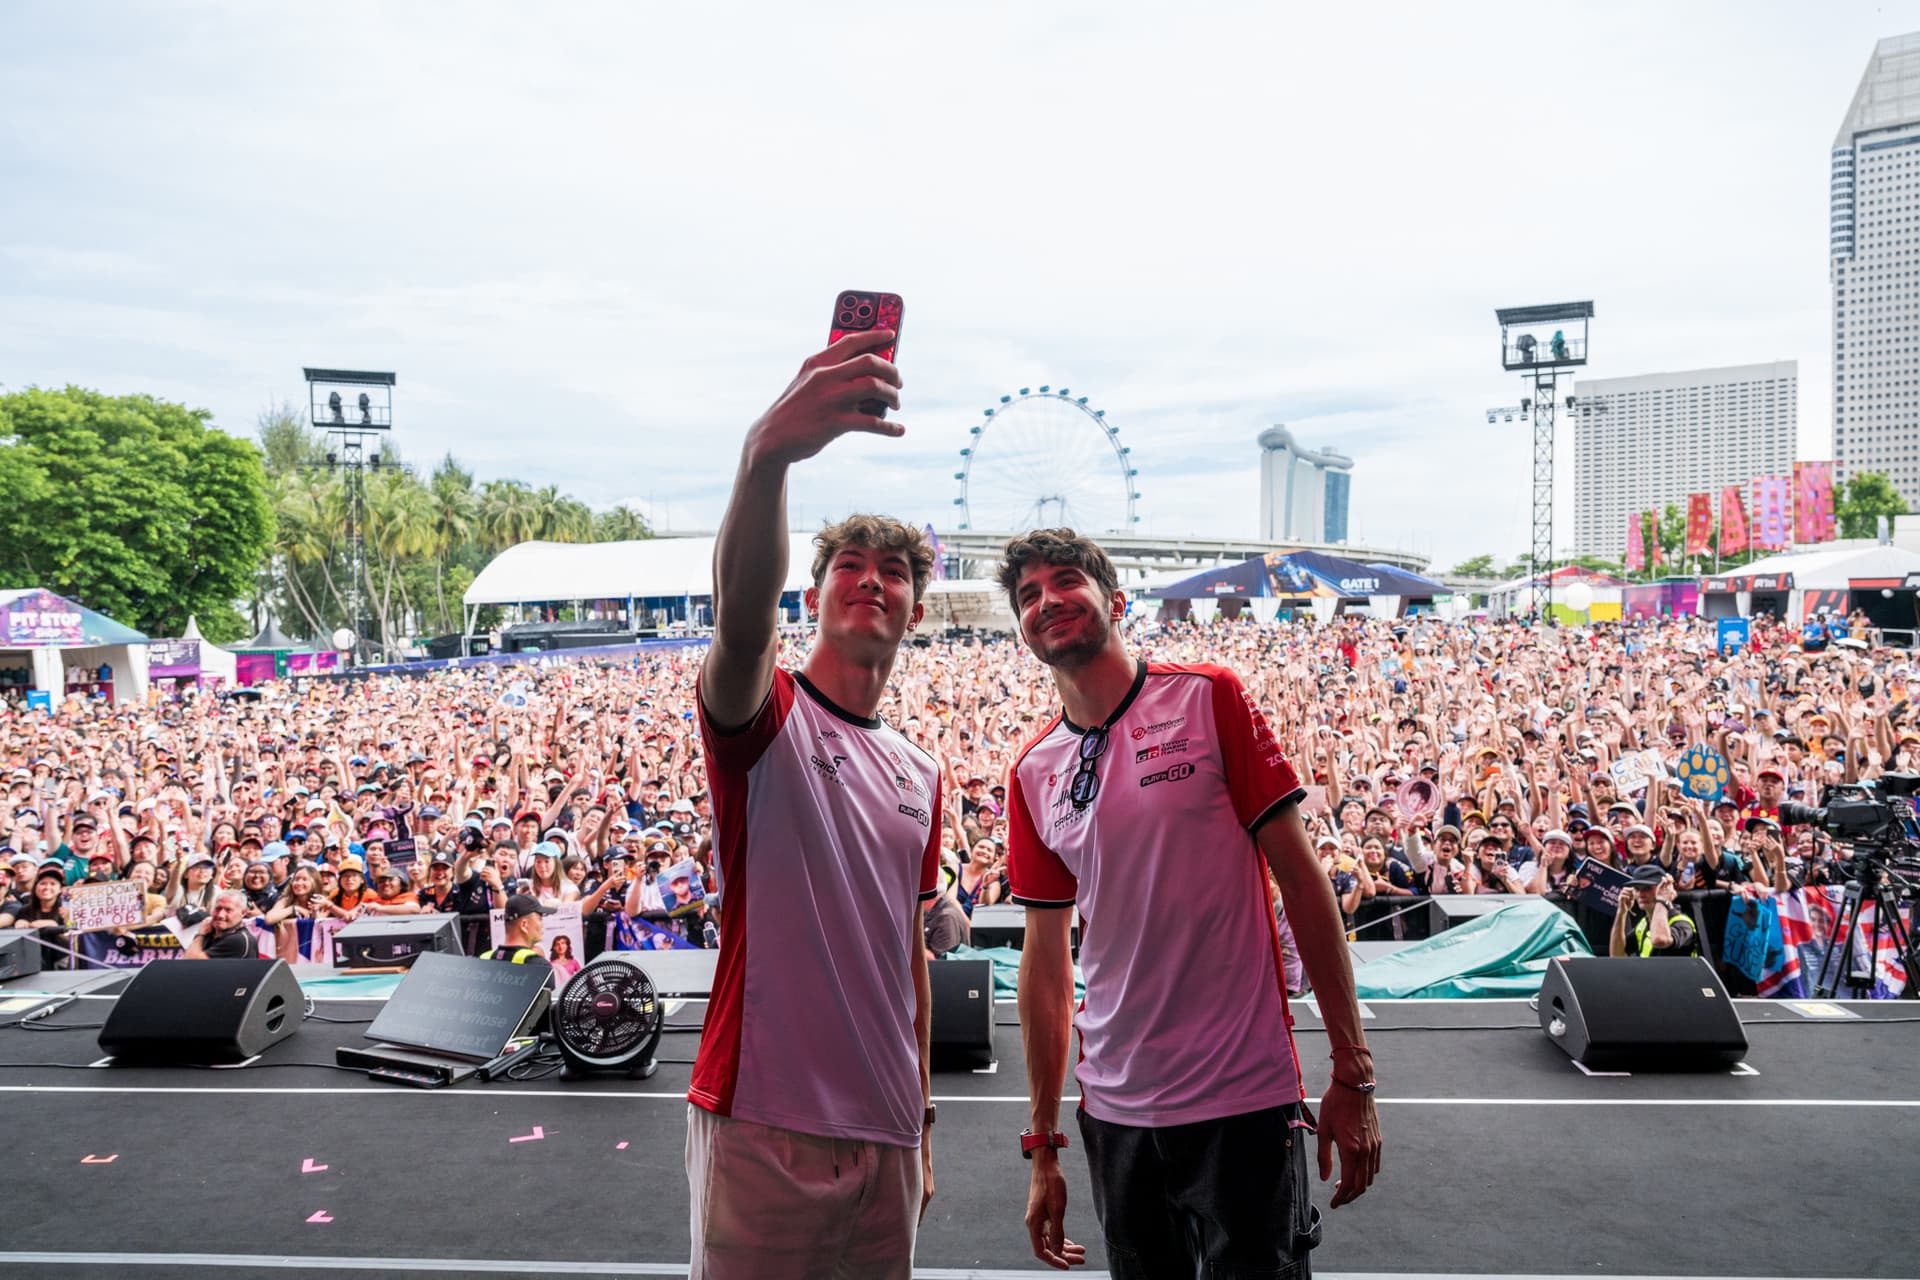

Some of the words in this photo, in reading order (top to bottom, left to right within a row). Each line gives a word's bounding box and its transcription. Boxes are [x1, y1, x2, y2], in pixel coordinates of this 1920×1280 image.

[1339, 577, 1372, 589] GATE
[1373, 577, 1380, 589] 1
[9, 612, 38, 627] PIT
[40, 612, 82, 627] STOP
[1168, 762, 1191, 781] GO
[73, 897, 114, 909] SPEED
[120, 894, 135, 905] UP
[73, 908, 86, 920] BE
[90, 904, 139, 918] CAREFUL
[79, 917, 103, 929] FOR
[135, 934, 180, 948] LLIE
[104, 948, 186, 965] BEARMA
[492, 969, 529, 987] Next
[463, 987, 503, 1005] Video
[460, 1010, 508, 1029] whose
